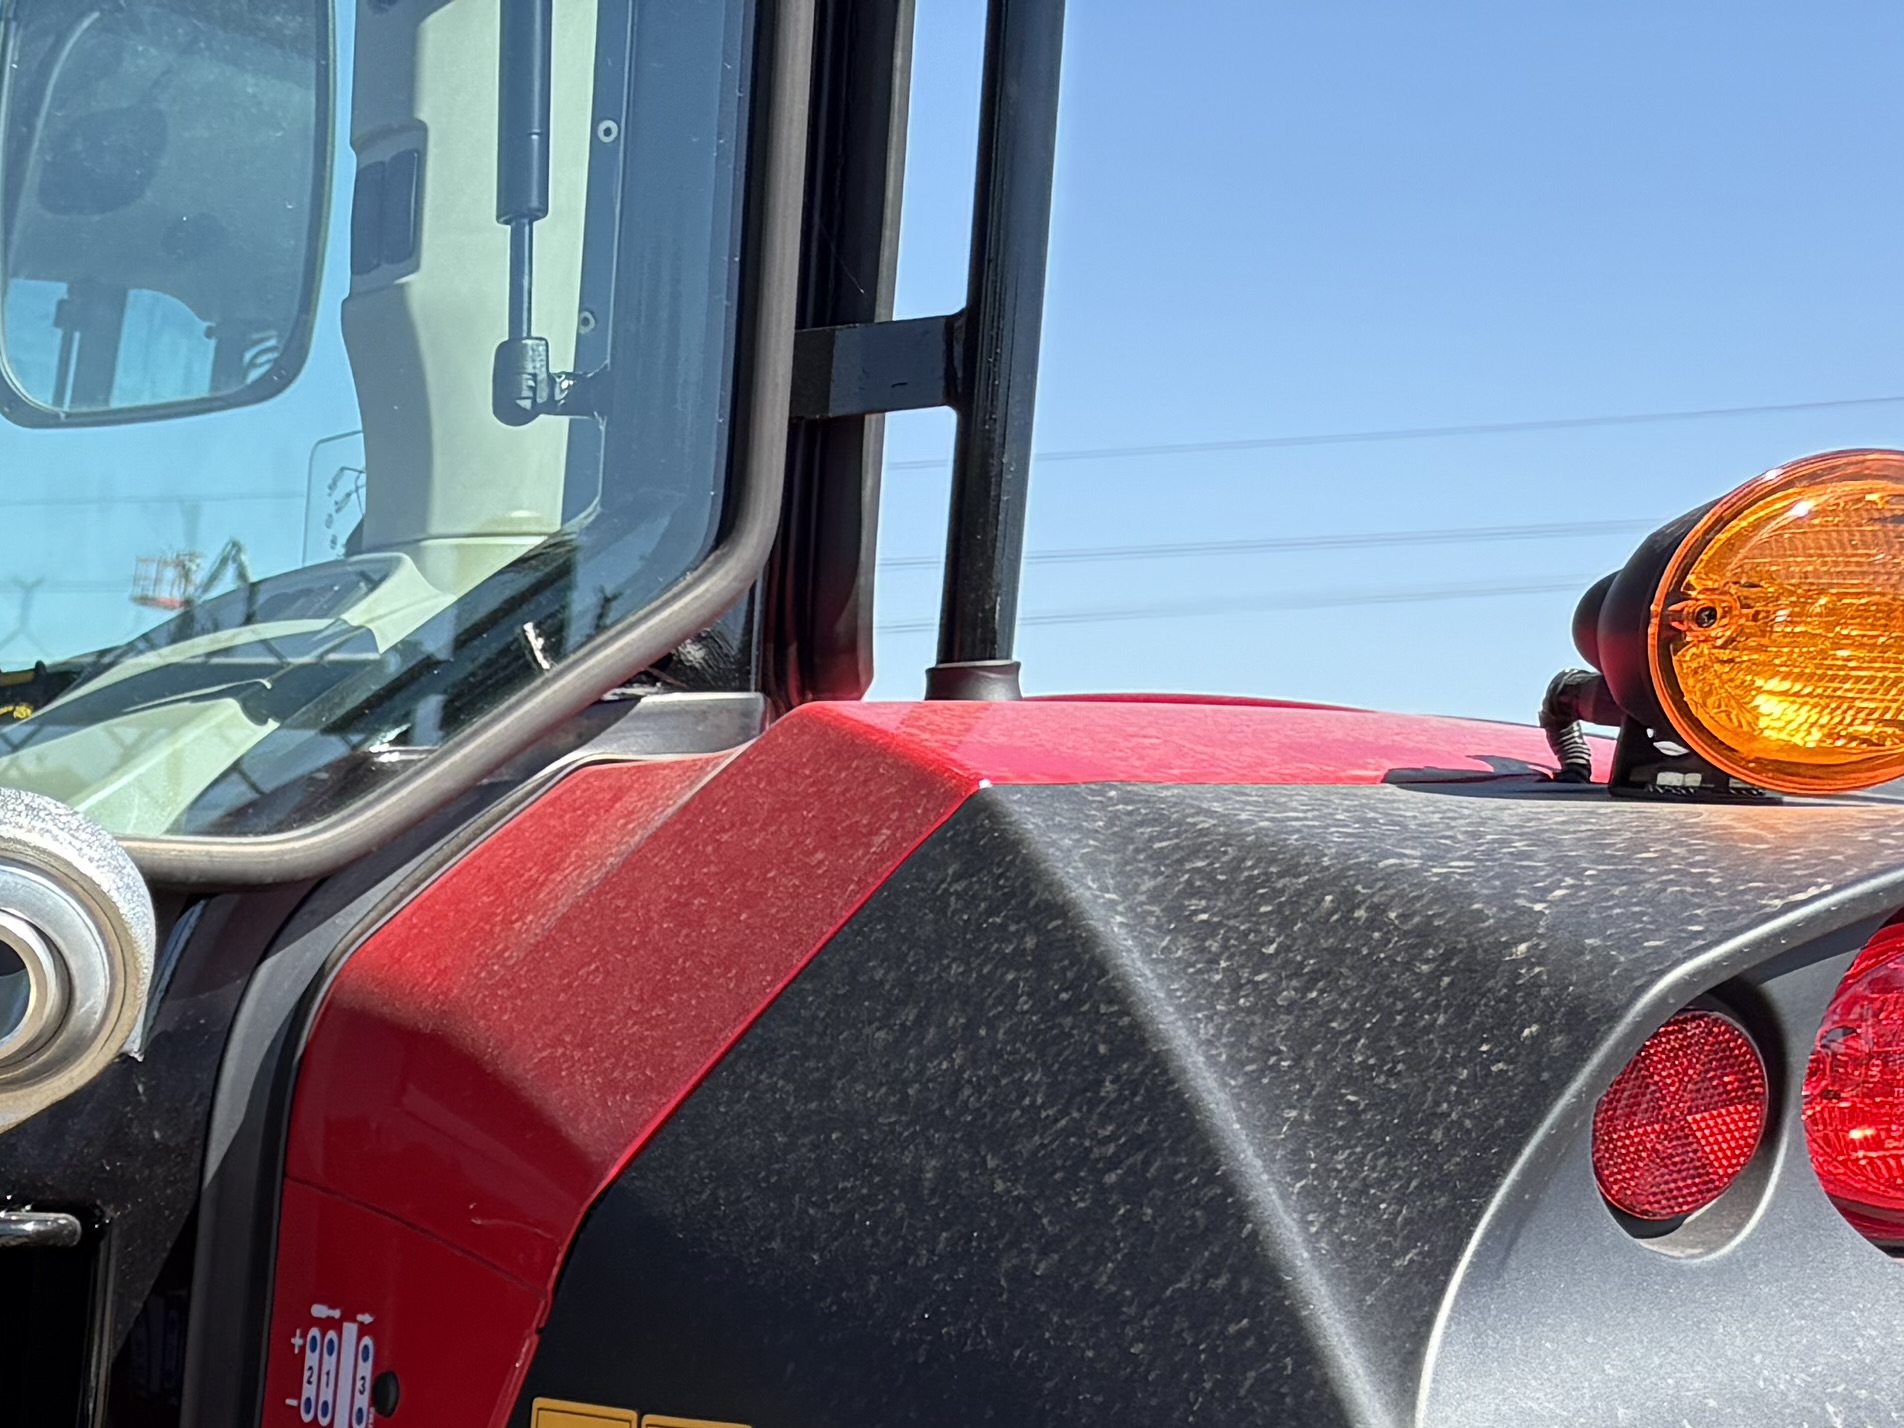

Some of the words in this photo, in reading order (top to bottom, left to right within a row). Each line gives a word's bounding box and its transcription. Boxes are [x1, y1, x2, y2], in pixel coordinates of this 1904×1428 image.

[305, 1365, 314, 1386] 2
[324, 1370, 331, 1389] 1
[357, 1375, 367, 1395] 3
